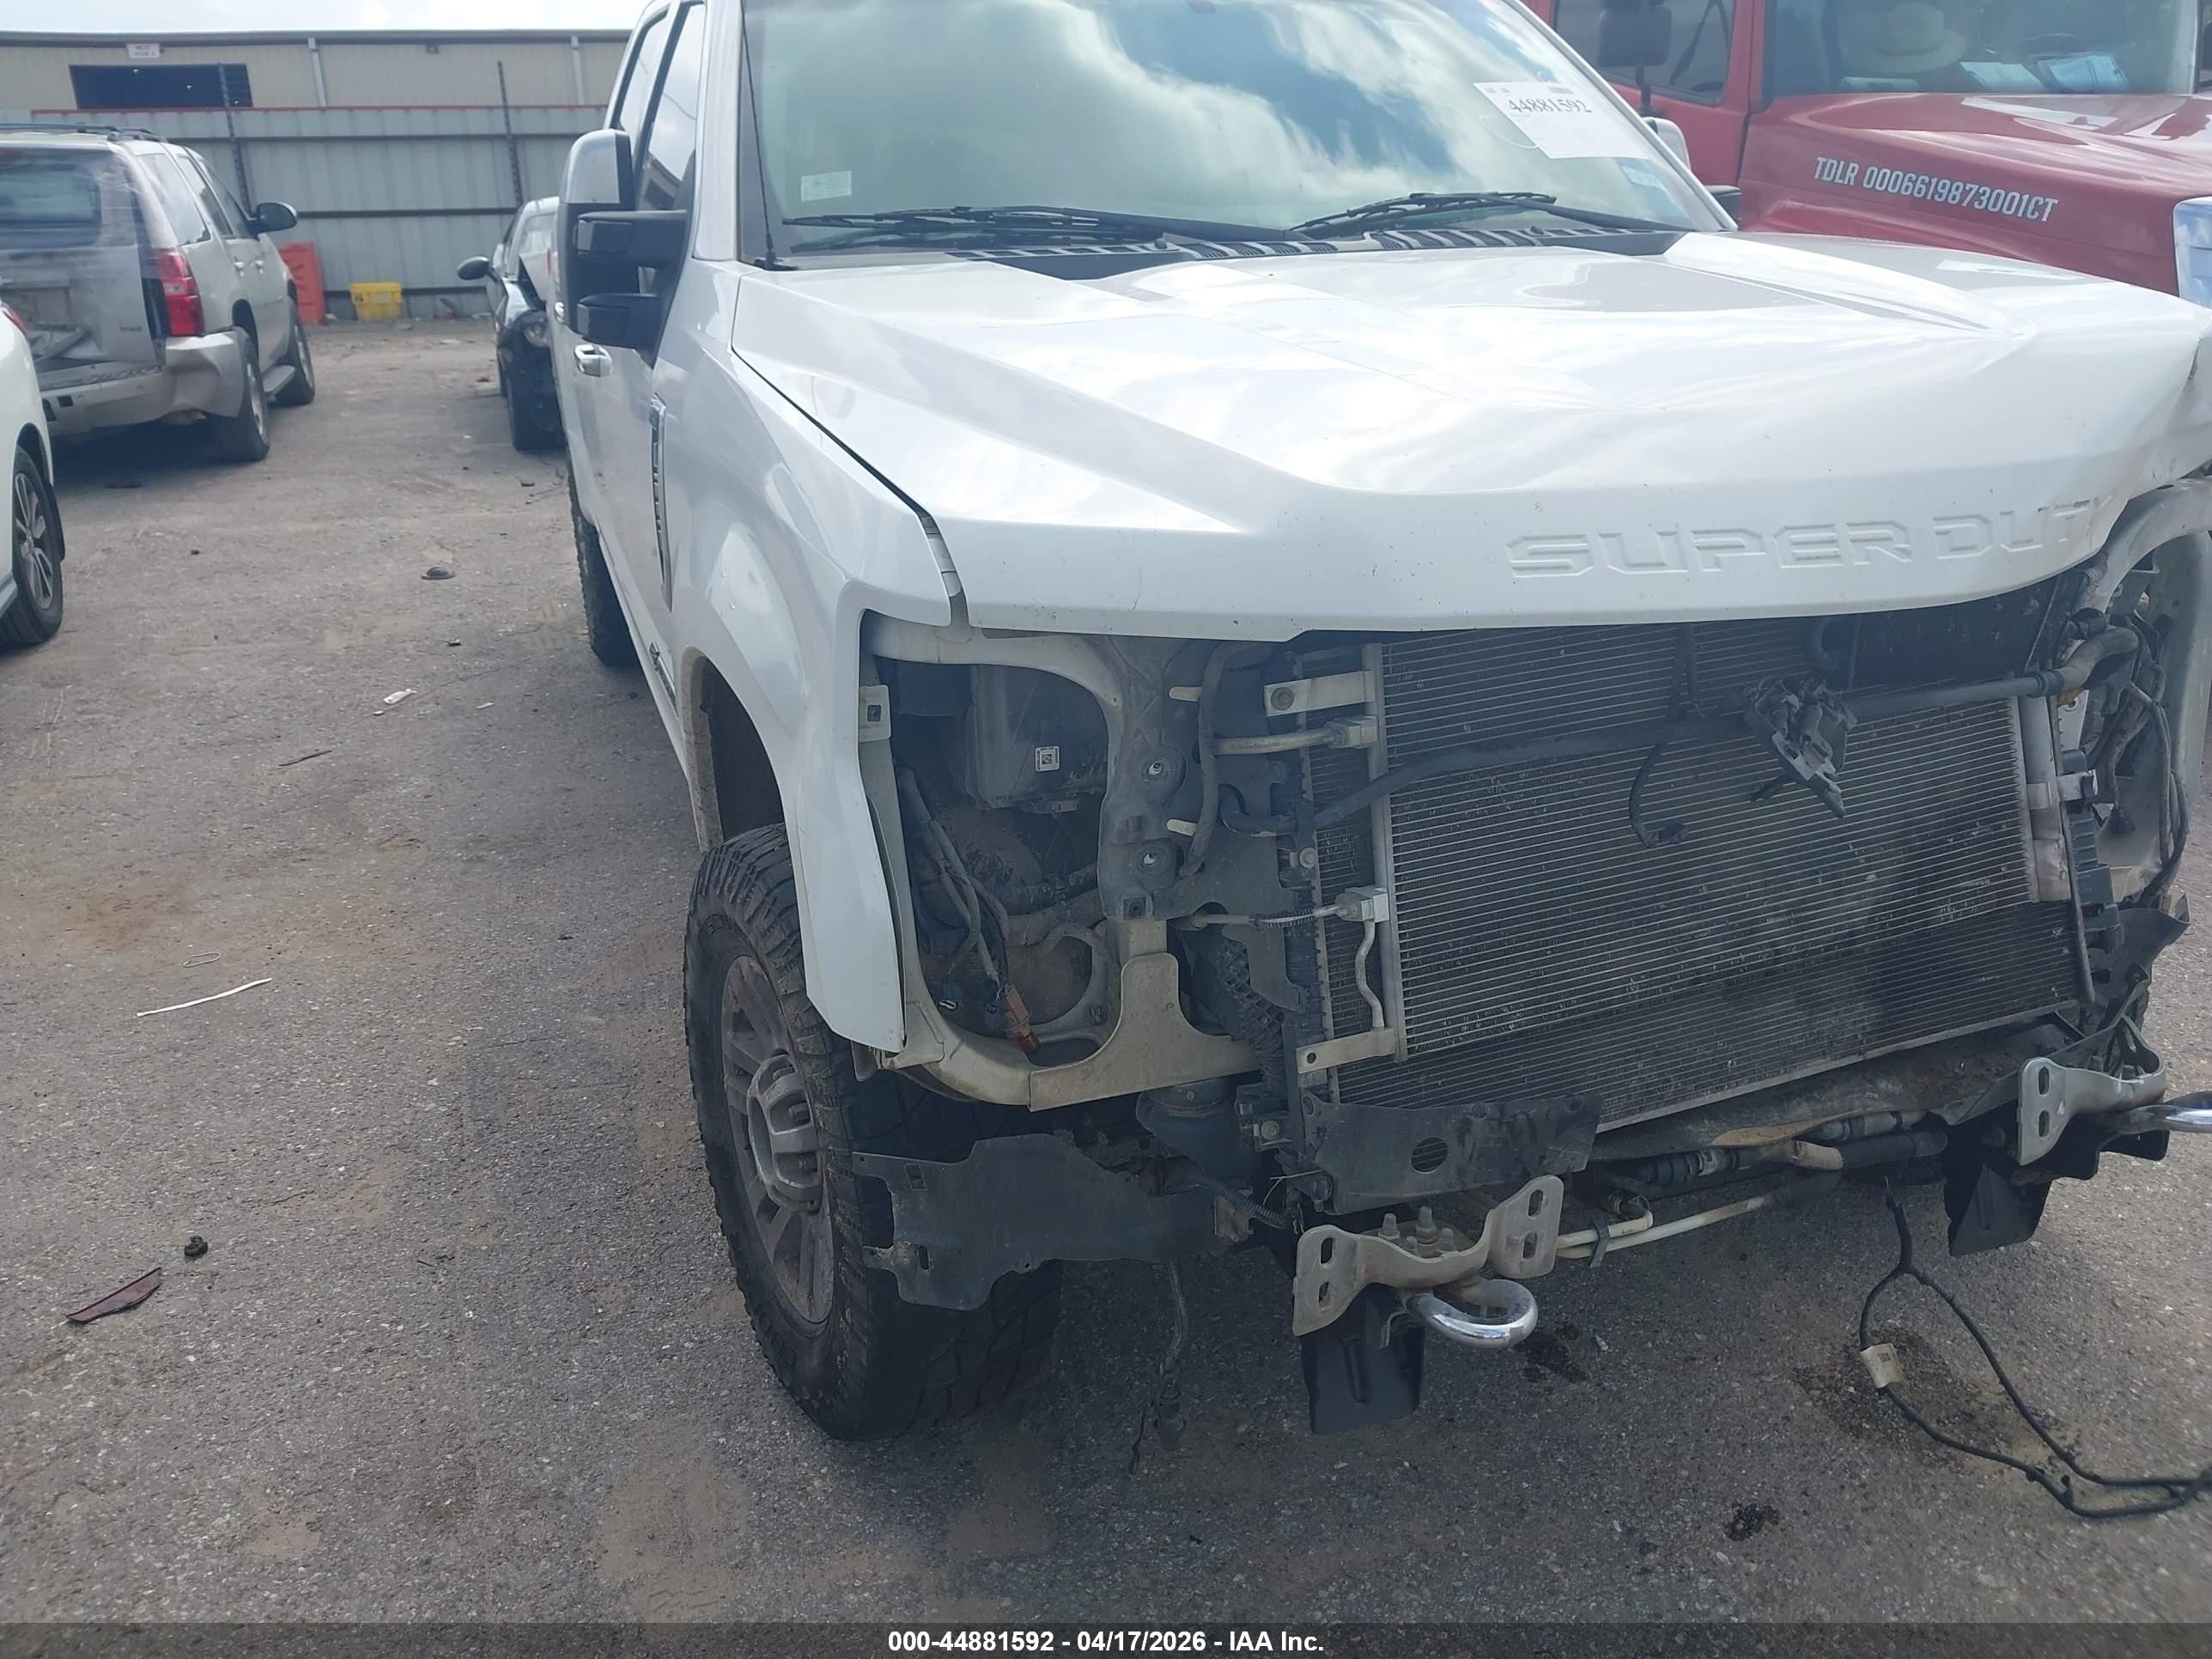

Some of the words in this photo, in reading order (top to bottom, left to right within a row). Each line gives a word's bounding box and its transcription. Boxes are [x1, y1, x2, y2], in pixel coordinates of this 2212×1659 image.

[1508, 97, 1593, 113] 44881592
[1814, 156, 1860, 186] TDLR
[1863, 165, 2059, 222] 0006619873001CT
[1506, 520, 1913, 578] SUPER
